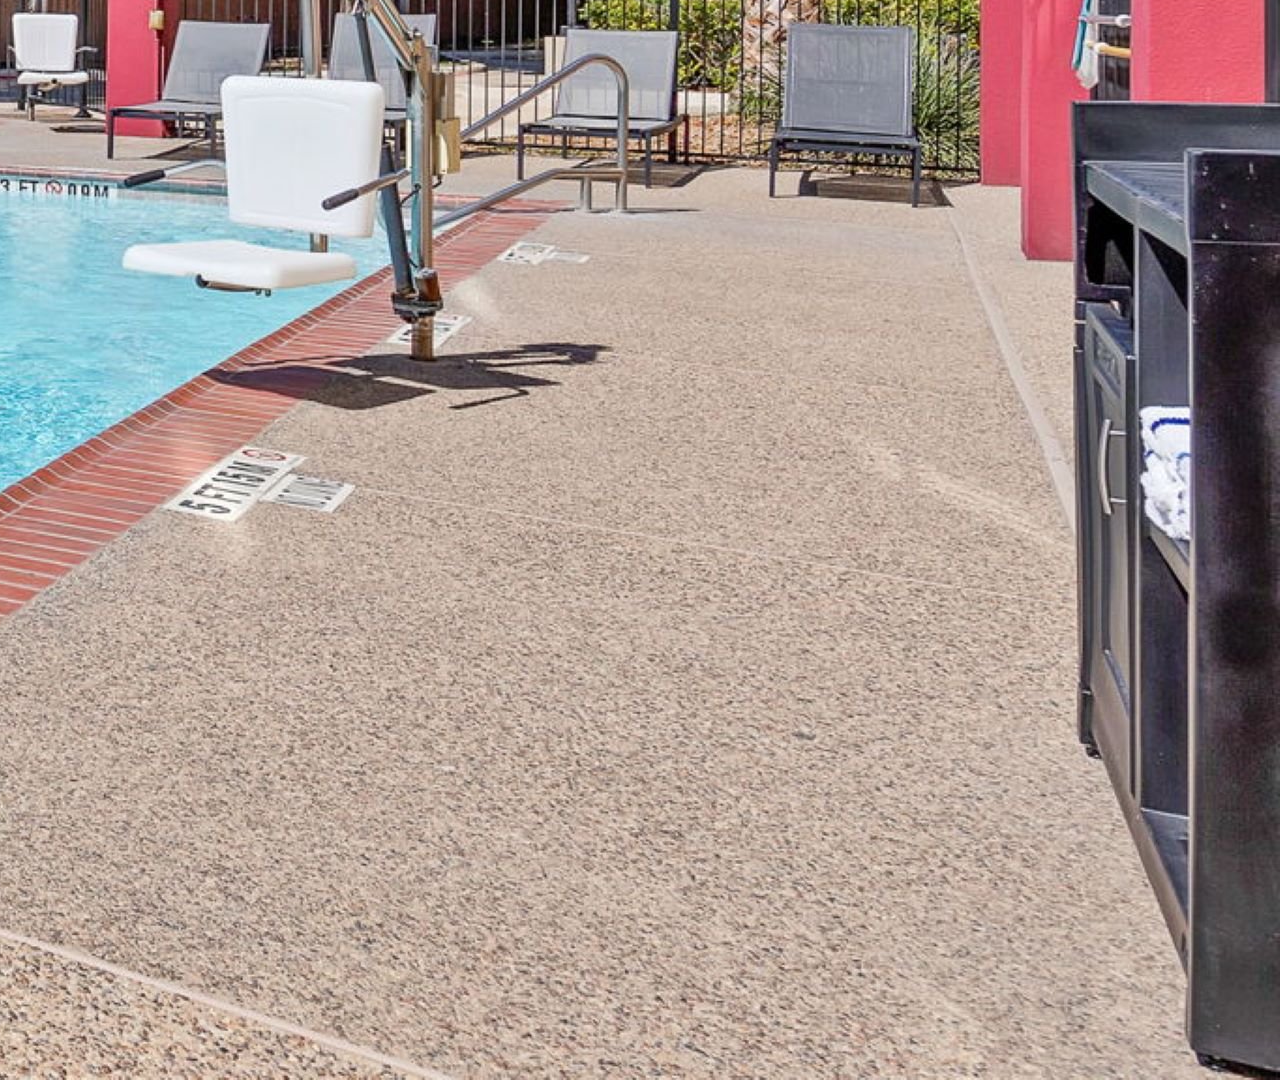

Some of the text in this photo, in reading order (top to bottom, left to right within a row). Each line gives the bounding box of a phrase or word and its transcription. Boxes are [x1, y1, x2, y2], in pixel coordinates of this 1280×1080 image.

[19, 179, 38, 193] FT
[193, 483, 251, 504] FT
[179, 499, 231, 514] 5
